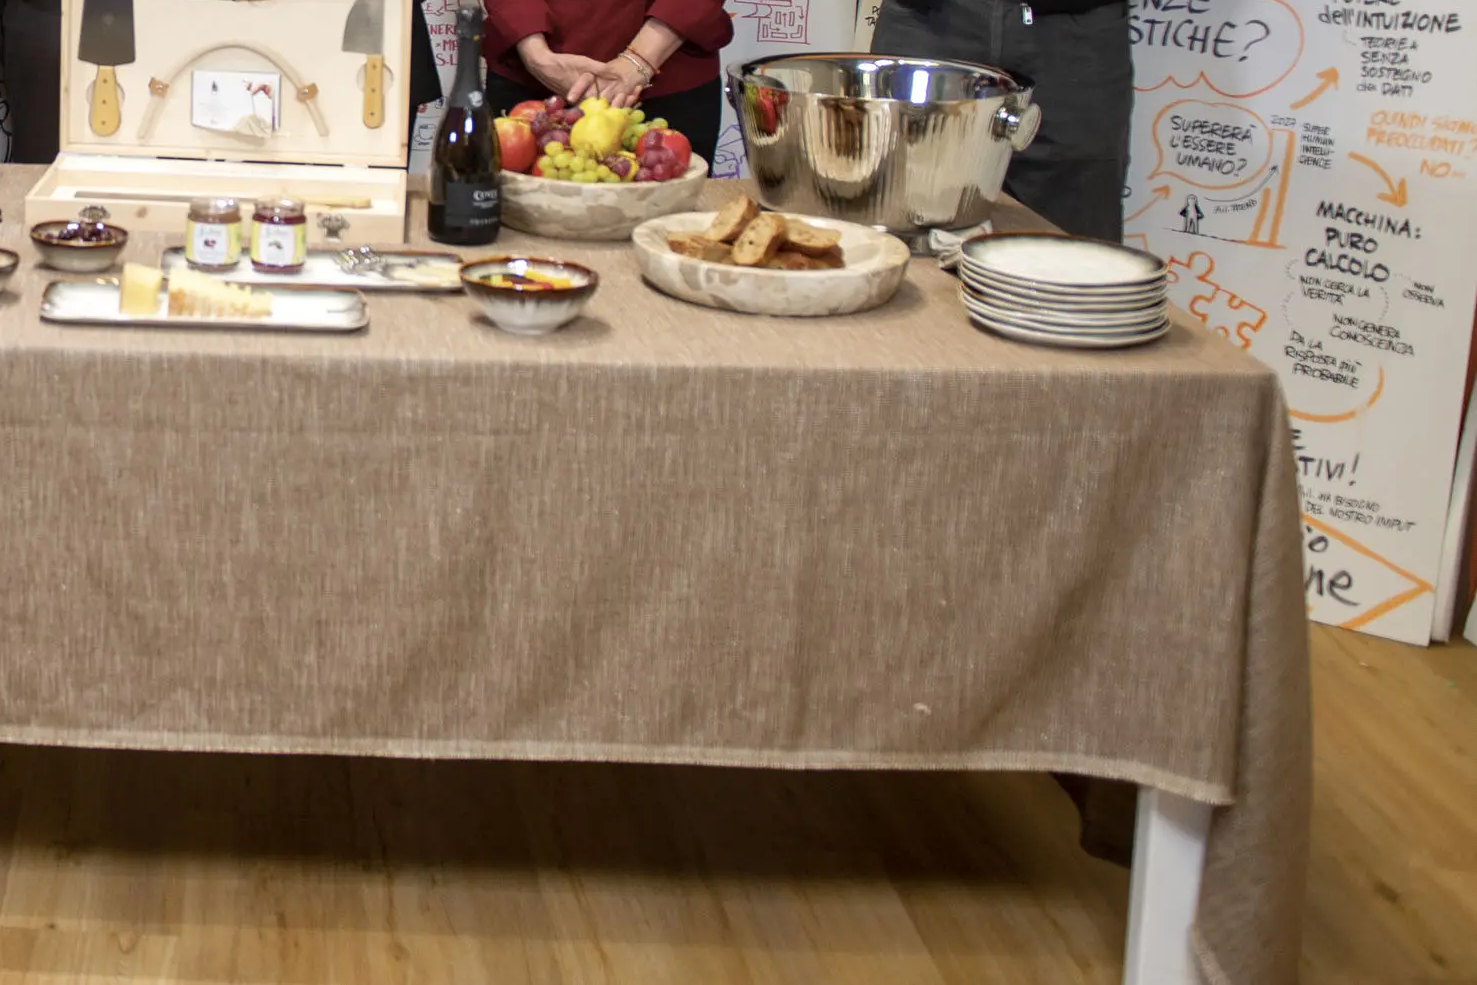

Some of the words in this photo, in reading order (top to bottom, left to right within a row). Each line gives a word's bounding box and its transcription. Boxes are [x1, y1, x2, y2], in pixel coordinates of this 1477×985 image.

[1170, 134, 1236, 156] L'ESSERE
[1176, 154, 1248, 178] UMANO?
[1316, 201, 1422, 239] MACCHINA:
[1326, 227, 1379, 254] PURO
[1304, 248, 1391, 283] CALCOLO
